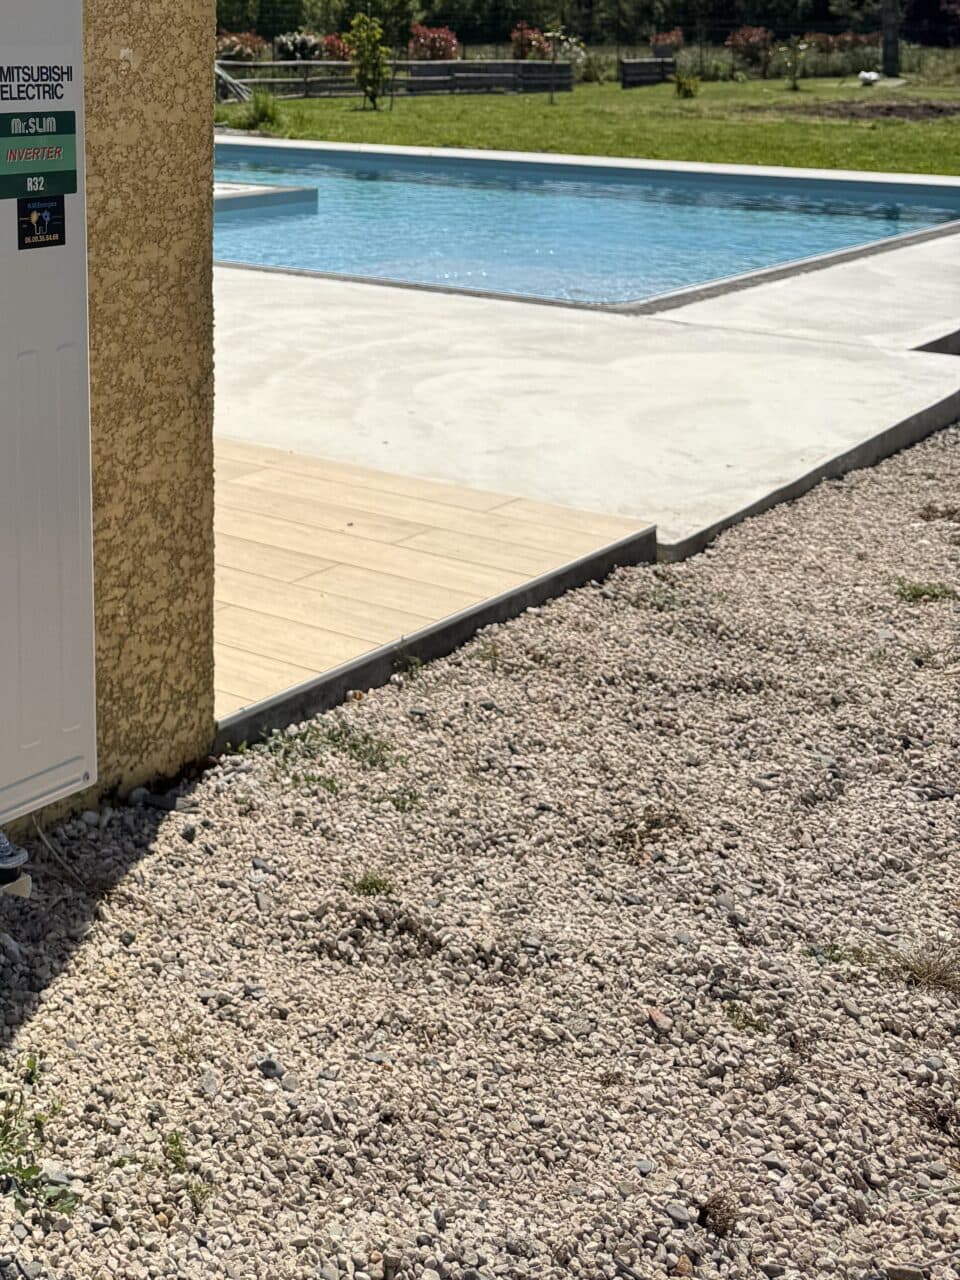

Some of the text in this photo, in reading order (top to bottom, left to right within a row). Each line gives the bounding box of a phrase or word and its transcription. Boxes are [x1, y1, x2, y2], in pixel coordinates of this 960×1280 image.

[0, 65, 73, 82] MITSUBISHI
[0, 83, 64, 100] ELECTRIC
[6, 146, 63, 162] INVERTER
[26, 176, 45, 191] R32
